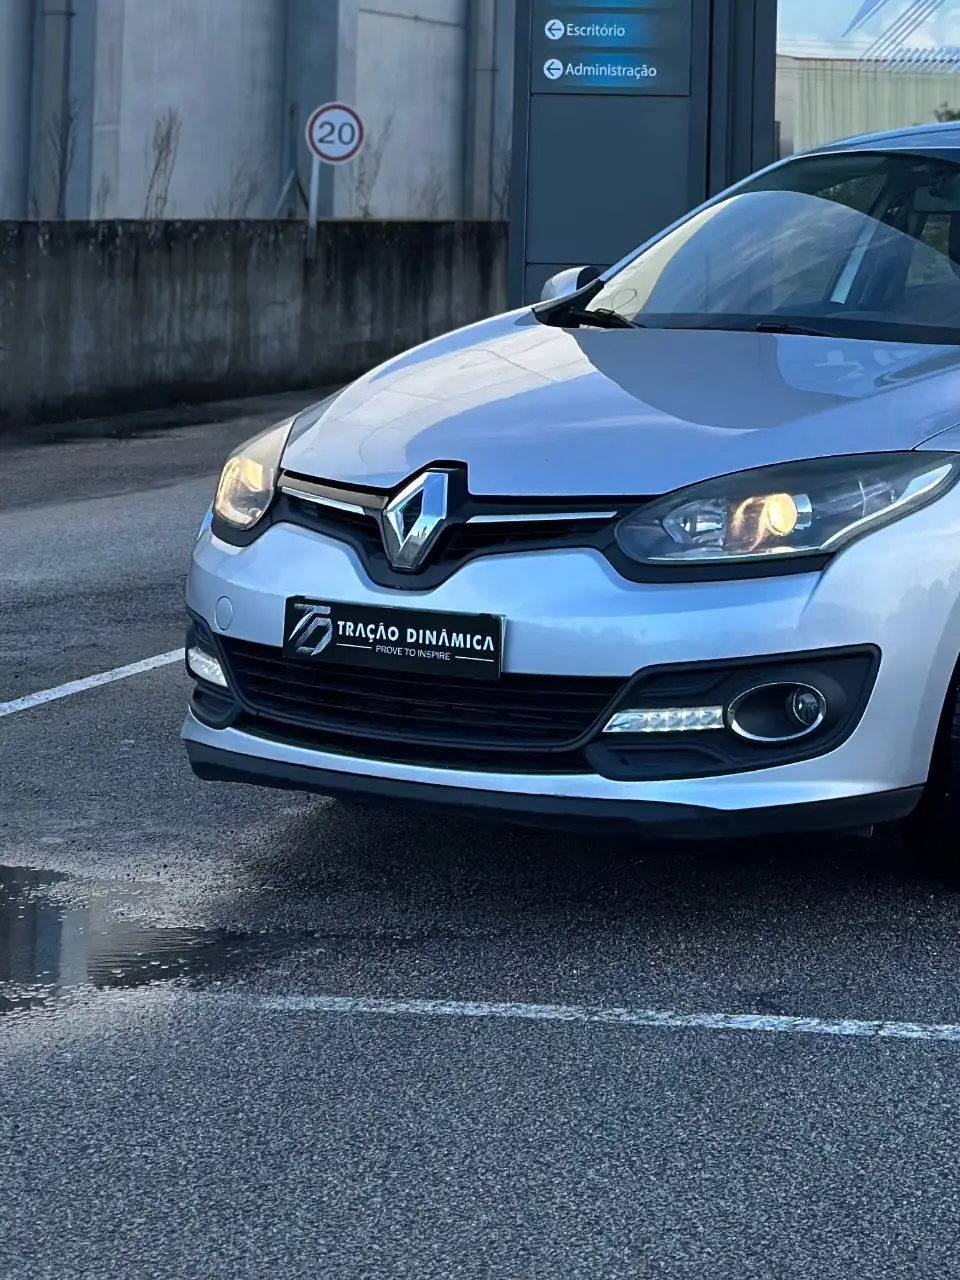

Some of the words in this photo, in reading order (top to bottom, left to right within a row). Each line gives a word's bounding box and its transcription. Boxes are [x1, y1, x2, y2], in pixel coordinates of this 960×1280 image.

[566, 23, 626, 37] Escritório
[565, 63, 657, 79] Administração
[317, 121, 356, 146] 20
[337, 621, 400, 643] TRAÇÃO
[406, 628, 495, 652] DINÂMICA
[375, 644, 403, 656] PROVE
[404, 647, 417, 657] TO
[417, 649, 451, 661] INSPIRE
